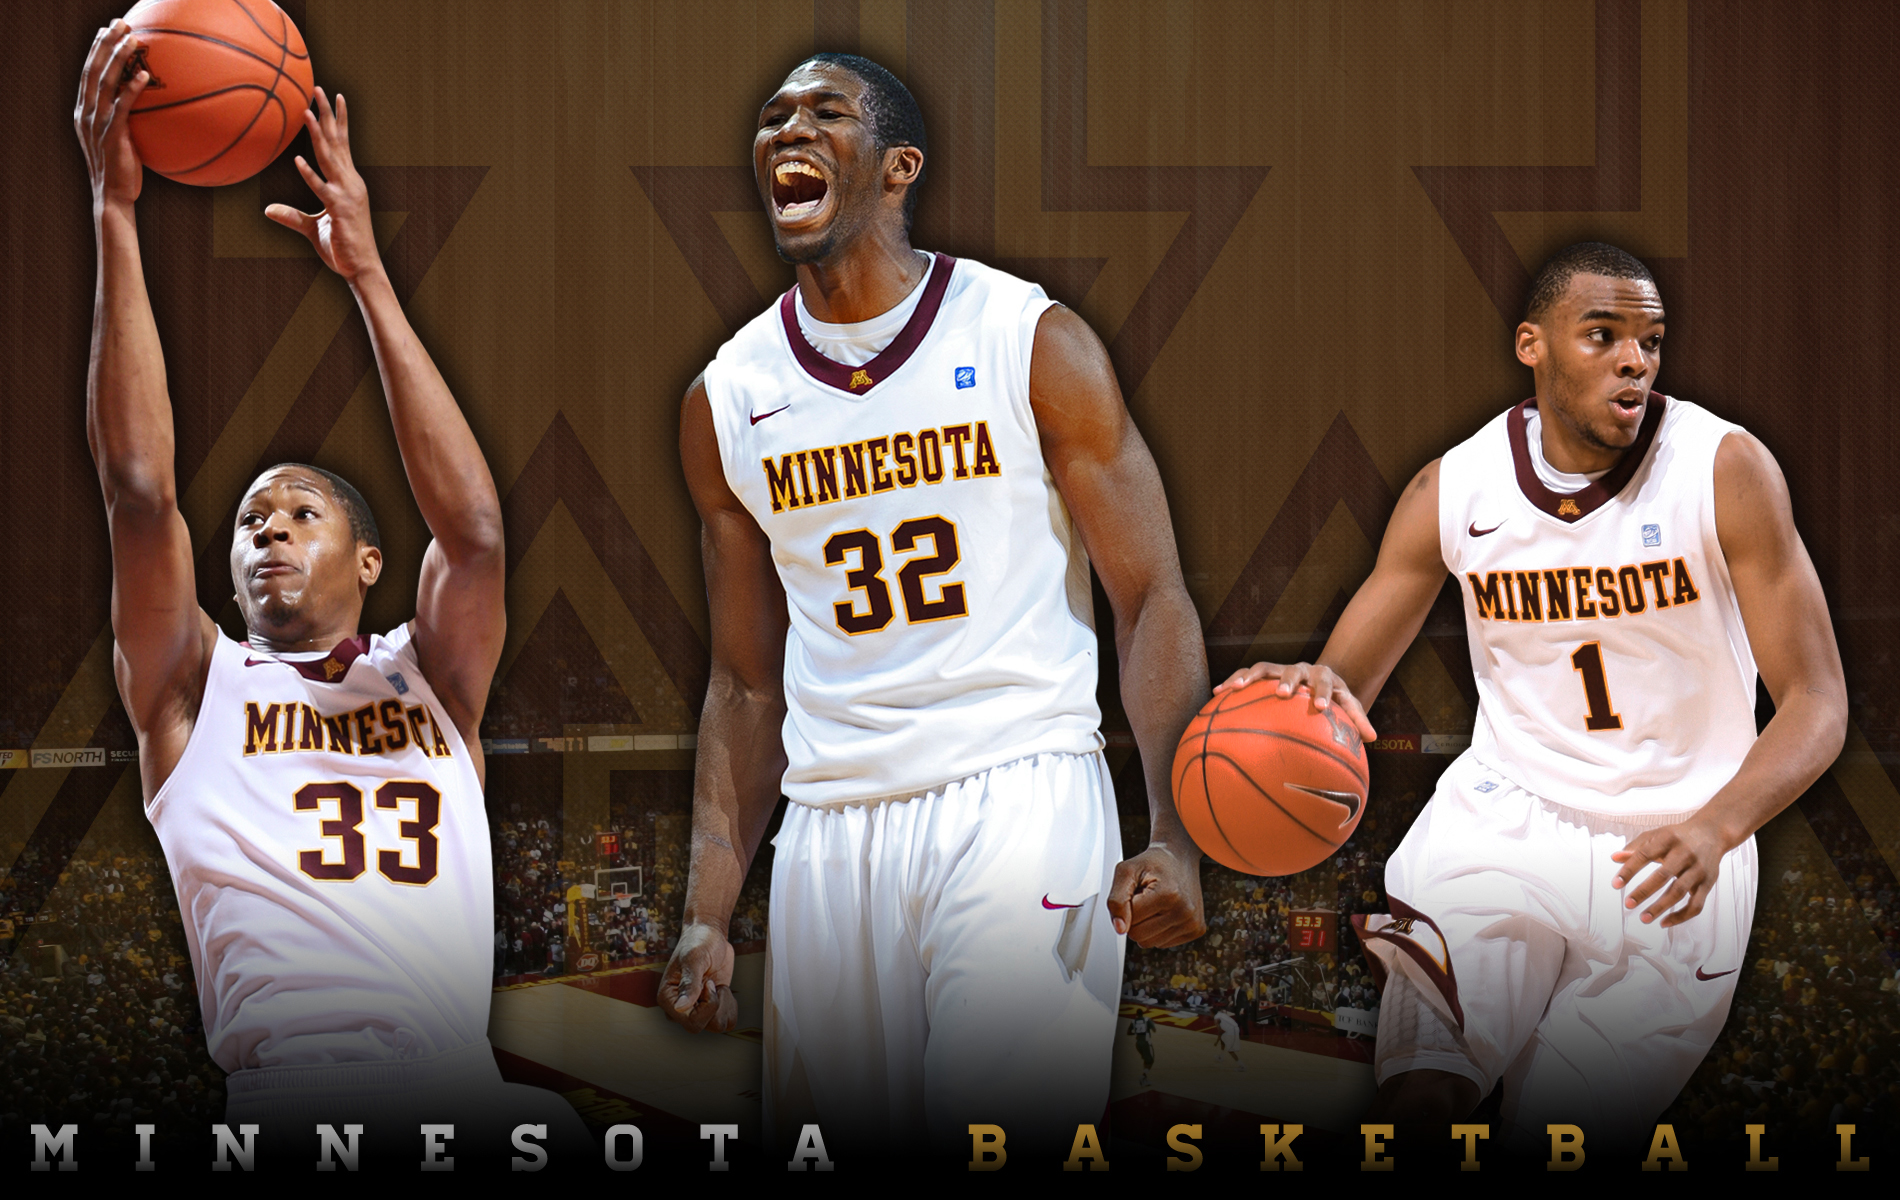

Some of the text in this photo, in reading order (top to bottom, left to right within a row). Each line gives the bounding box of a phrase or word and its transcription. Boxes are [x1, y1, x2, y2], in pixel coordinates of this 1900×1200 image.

[761, 420, 1002, 514] MINNESOTA
[822, 514, 969, 637] 32
[1466, 556, 1701, 623] MINNESOTA
[1570, 640, 1624, 732] 1
[243, 697, 453, 759] MINNESTA
[292, 778, 442, 887] 33
[1295, 916, 1322, 927] 53.3
[1299, 930, 1326, 947] 31
